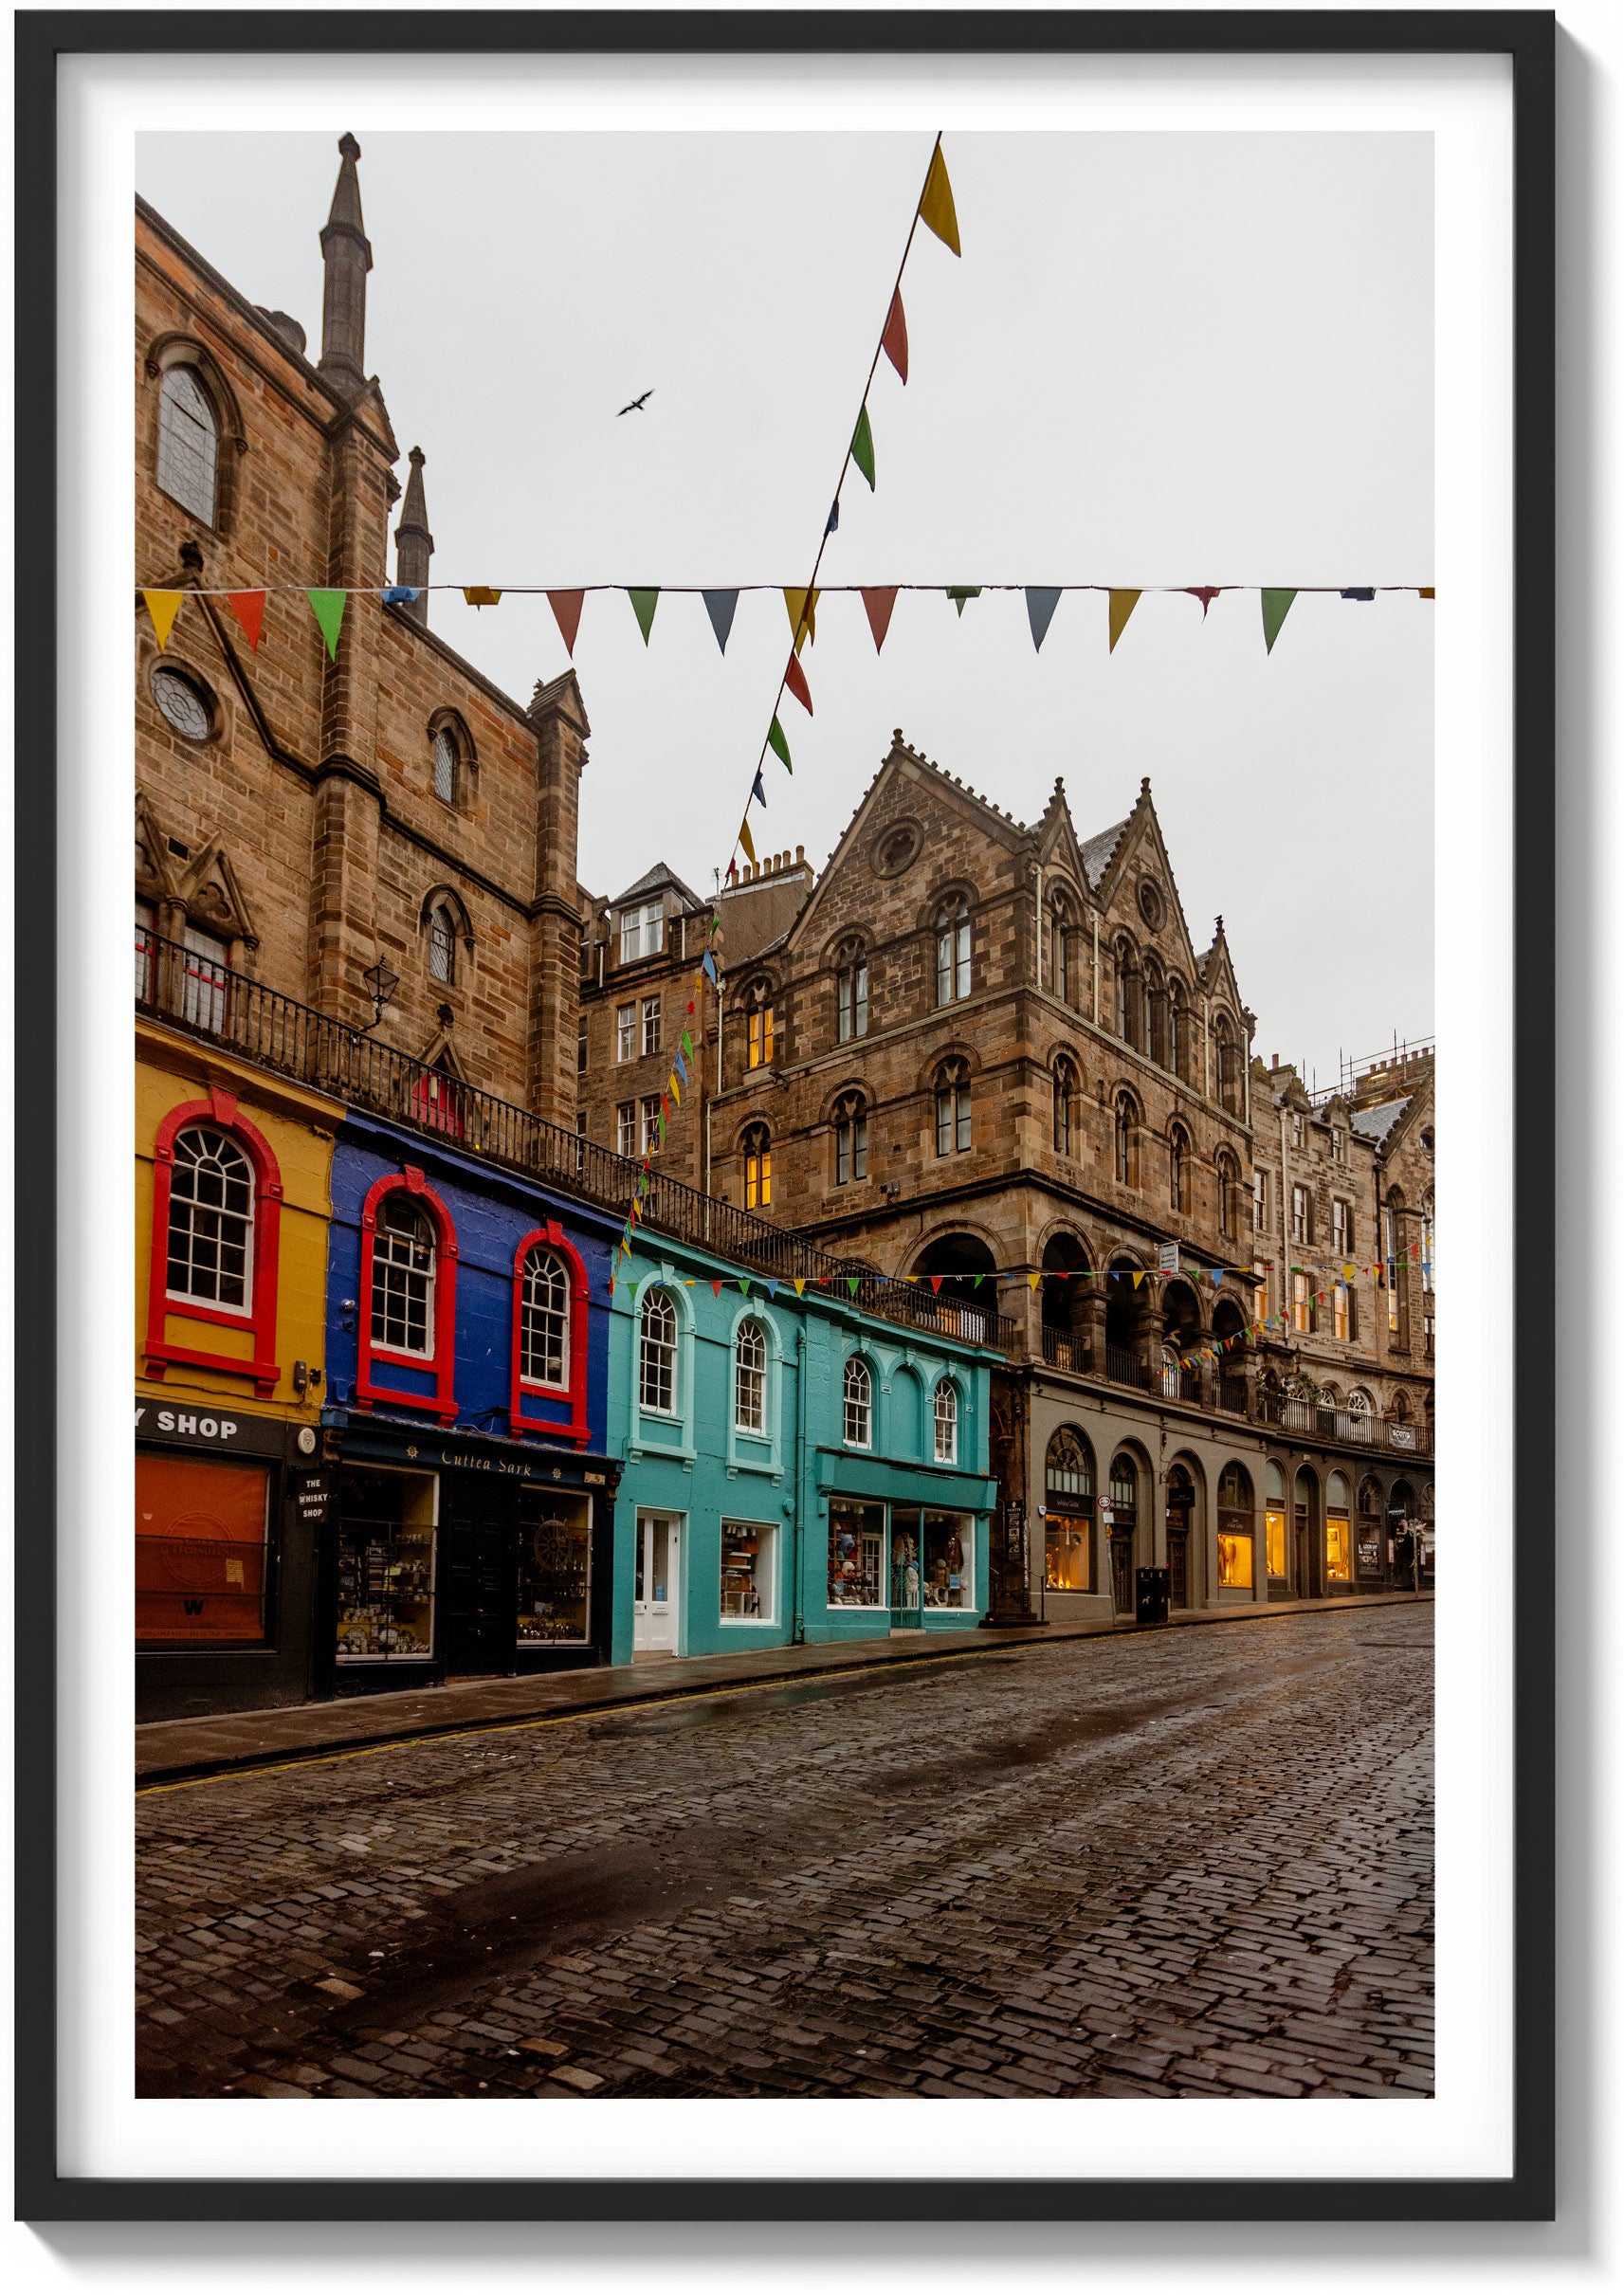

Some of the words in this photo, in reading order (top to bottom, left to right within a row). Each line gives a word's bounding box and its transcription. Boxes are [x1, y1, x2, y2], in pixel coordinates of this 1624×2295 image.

[156, 1411, 238, 1439] SHOP
[441, 1449, 491, 1470] Cuttea
[498, 1457, 532, 1476] Sark
[306, 1479, 320, 1487] THE
[299, 1493, 328, 1504] WHISKY
[302, 1508, 323, 1518] SHOP
[183, 1599, 203, 1615] W
